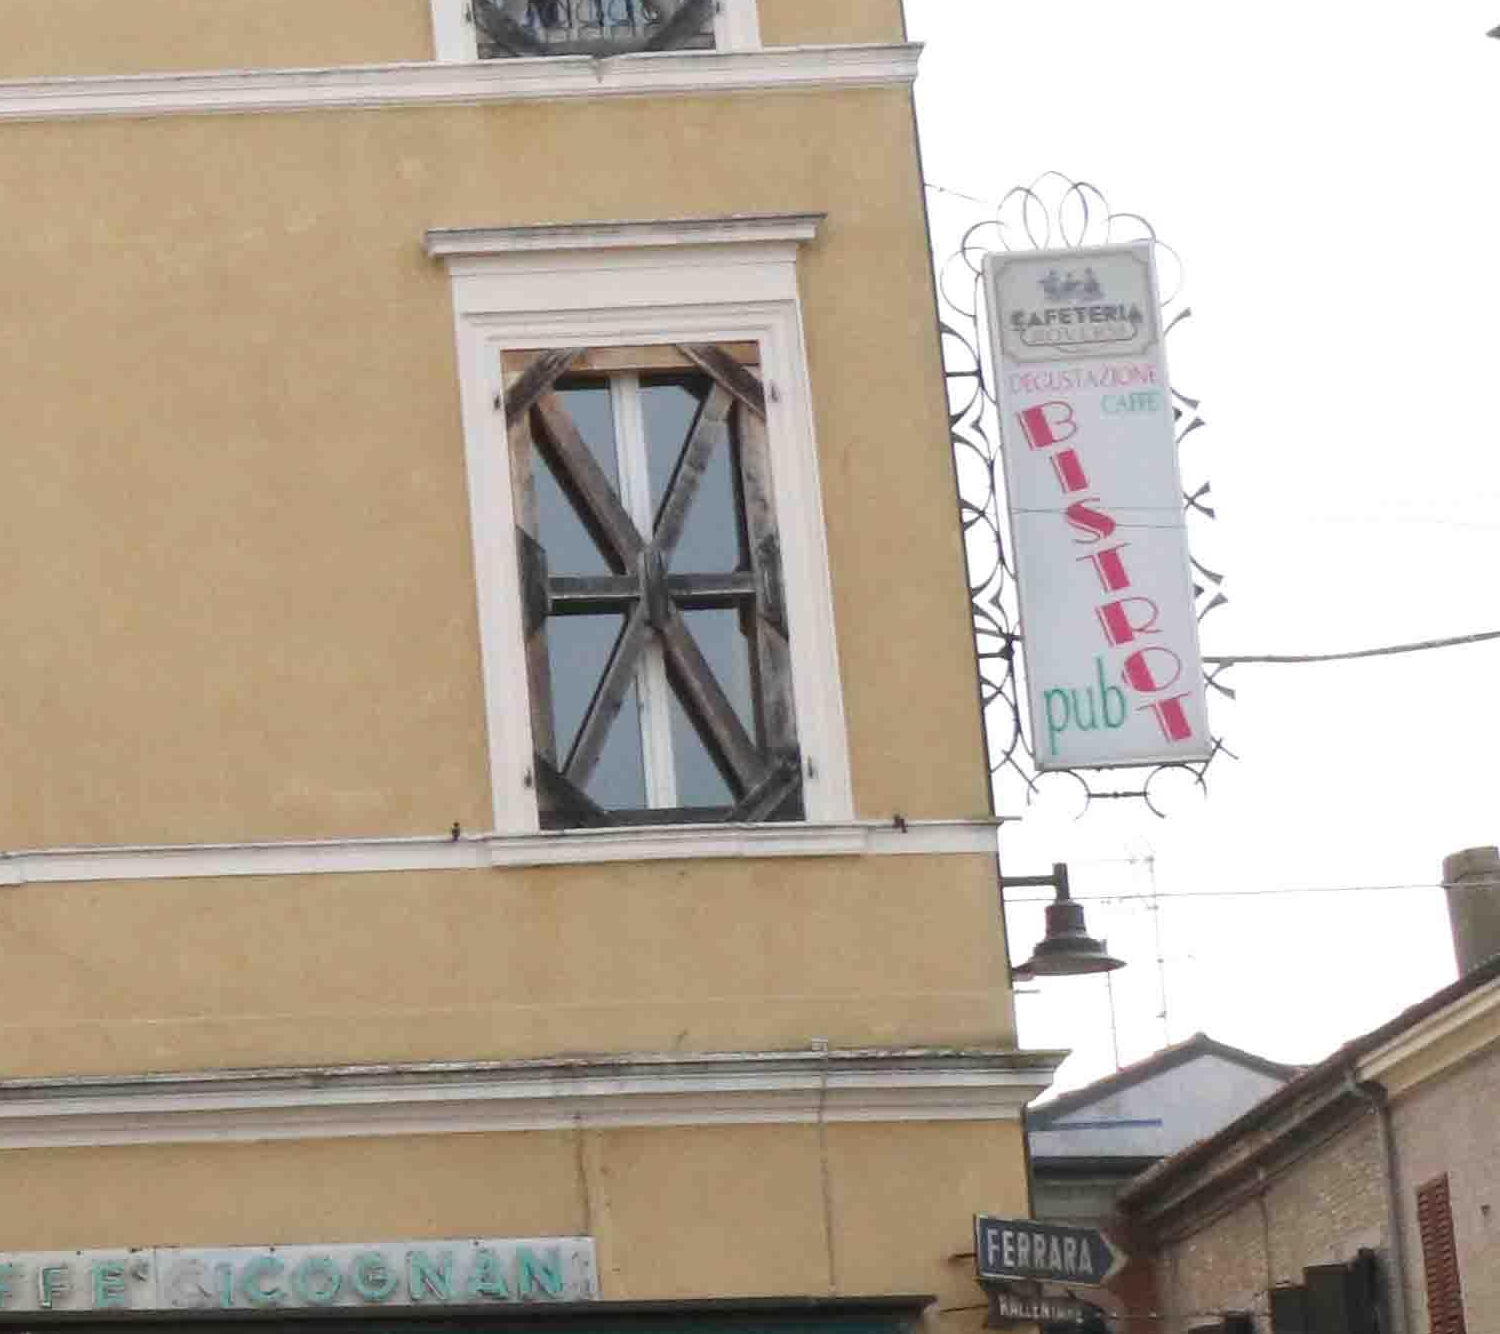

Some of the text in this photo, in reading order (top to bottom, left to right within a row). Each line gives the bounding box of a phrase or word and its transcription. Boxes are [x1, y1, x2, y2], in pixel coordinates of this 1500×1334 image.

[1010, 303, 1144, 329] CAFETERIA
[1007, 363, 1159, 396] DEGUSTAZIONE
[1015, 400, 1193, 743] BISTROT
[1044, 656, 1127, 755] pub
[987, 1227, 1094, 1275] FERRARA
